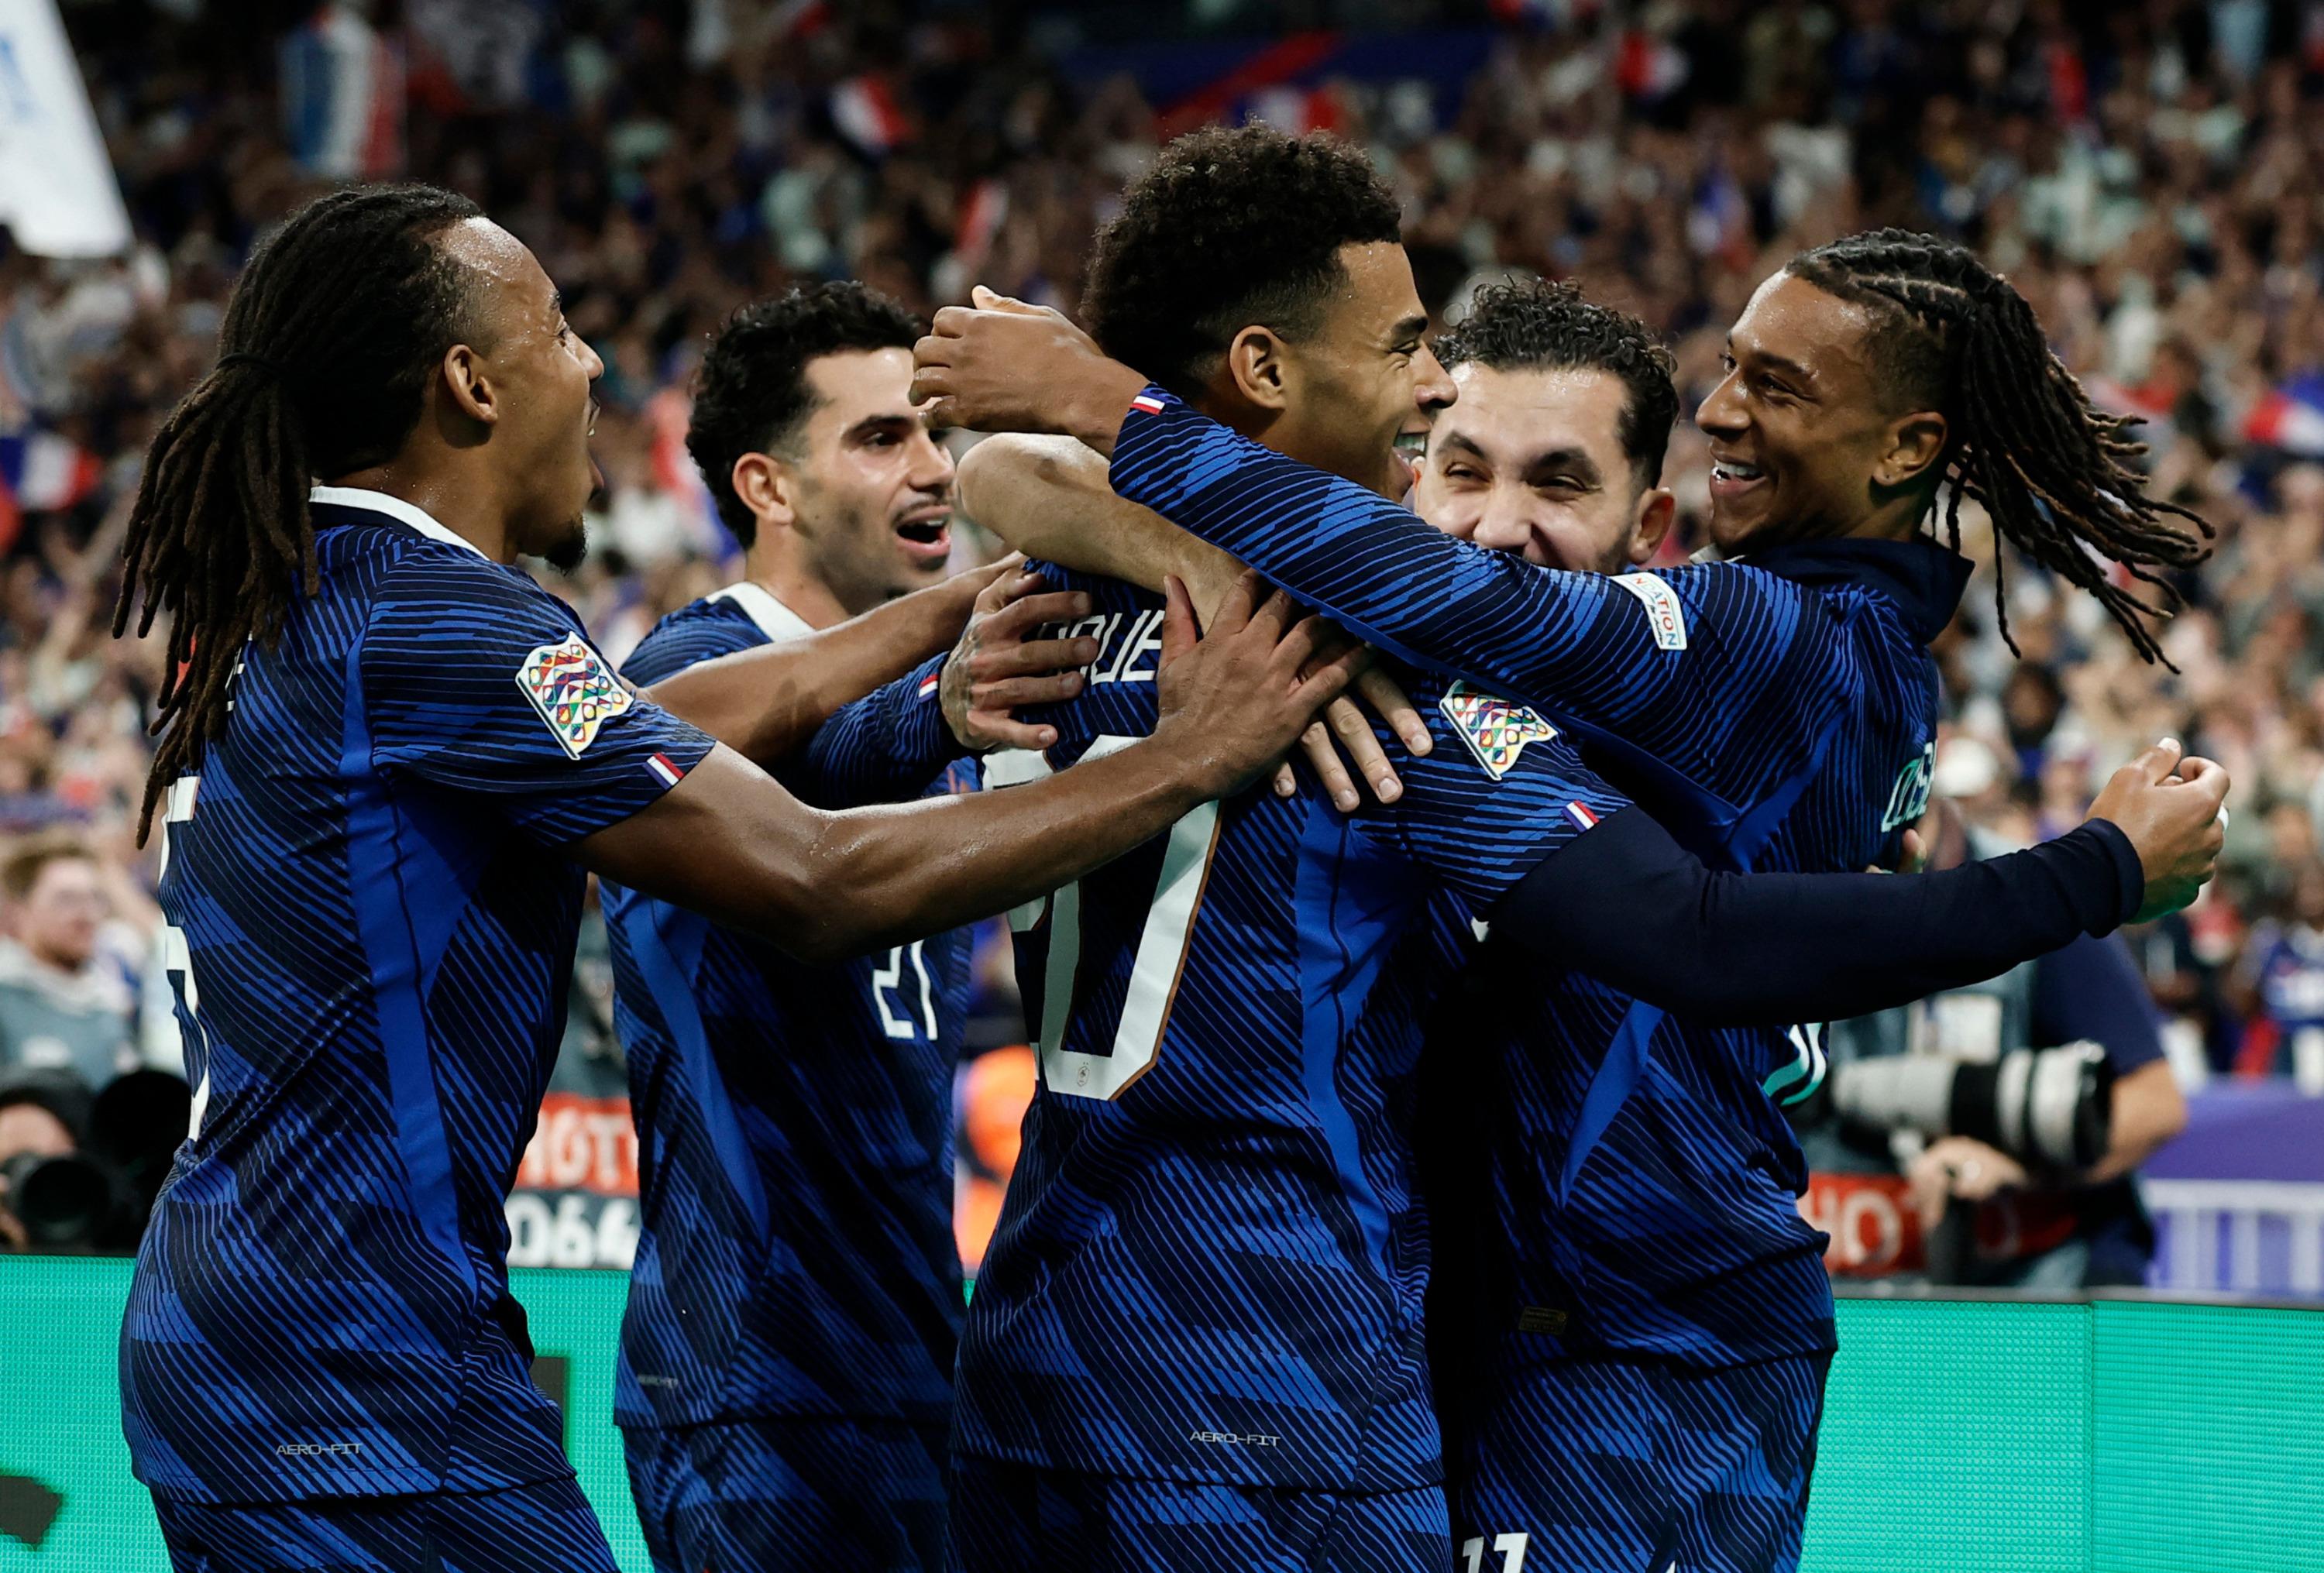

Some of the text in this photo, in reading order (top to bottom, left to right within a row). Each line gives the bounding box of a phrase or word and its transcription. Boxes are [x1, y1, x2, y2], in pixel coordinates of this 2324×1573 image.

[872, 939, 938, 1041] 21
[1189, 1430, 1281, 1447] AERO-FIT
[275, 1443, 363, 1455] AERO-FIT
